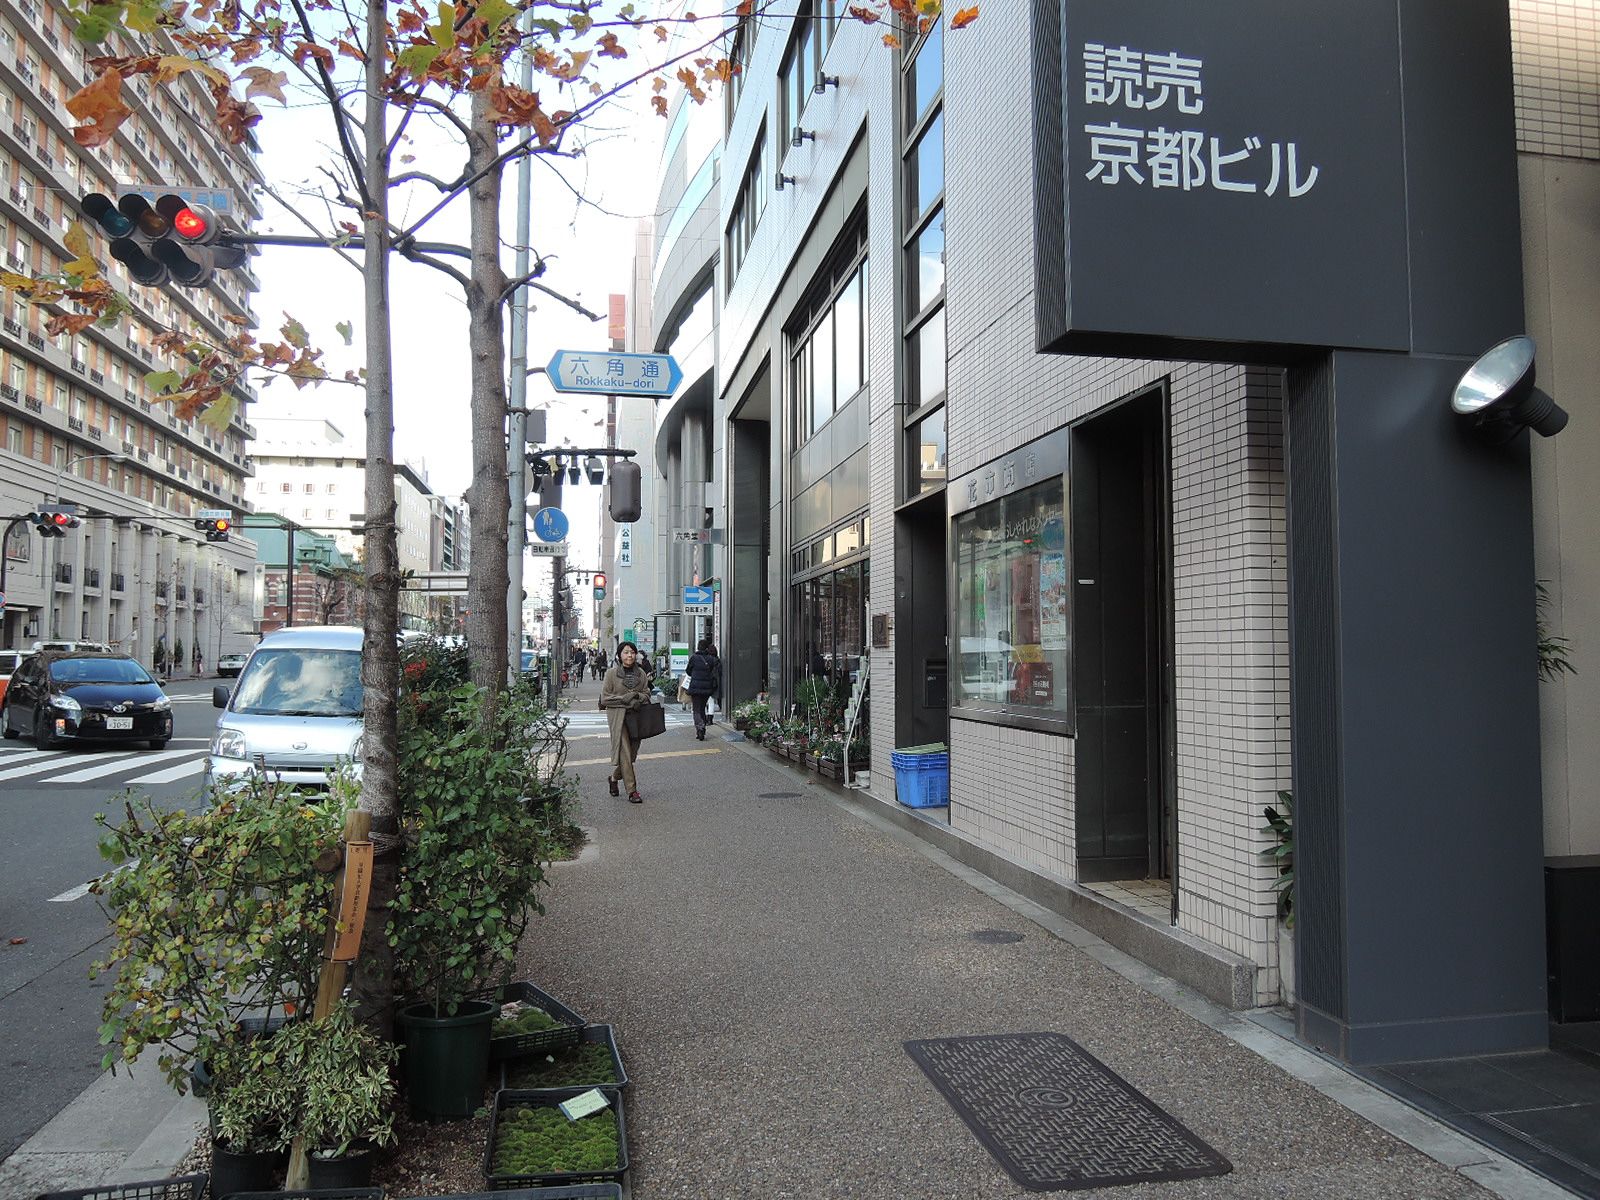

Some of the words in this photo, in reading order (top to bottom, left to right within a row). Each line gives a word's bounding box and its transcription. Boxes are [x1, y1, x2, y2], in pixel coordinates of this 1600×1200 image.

[1083, 42, 1204, 116] 読売
[1084, 121, 1319, 198] 京都ビル
[570, 357, 660, 378] 六角通
[576, 376, 655, 390] Rokkaku-dori
[621, 528, 630, 563] 公益社
